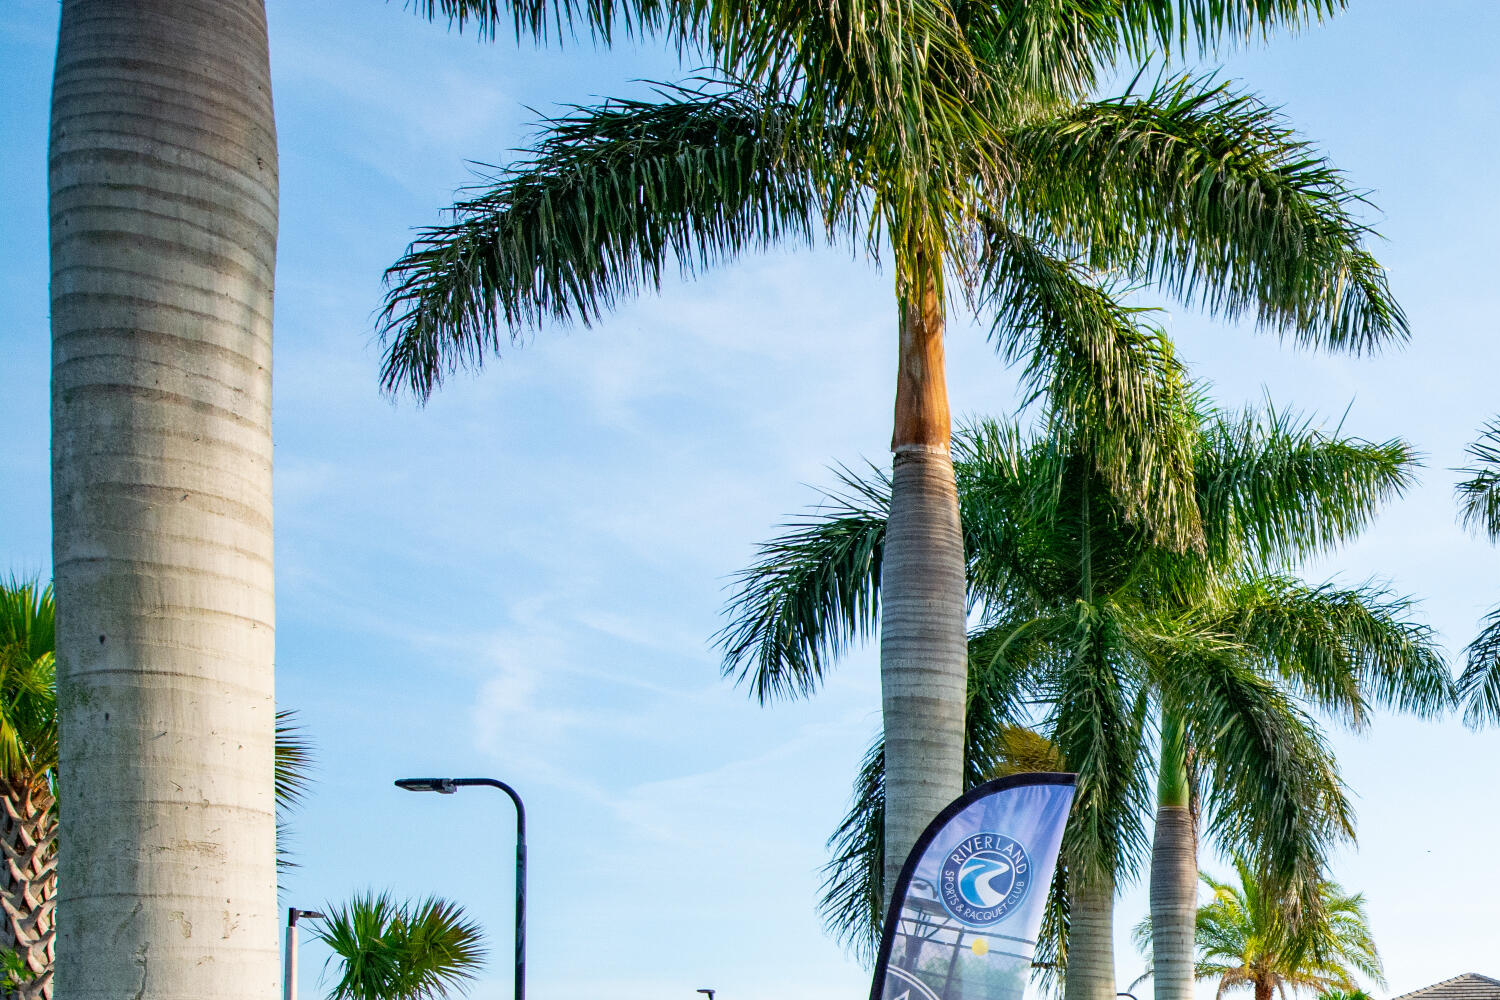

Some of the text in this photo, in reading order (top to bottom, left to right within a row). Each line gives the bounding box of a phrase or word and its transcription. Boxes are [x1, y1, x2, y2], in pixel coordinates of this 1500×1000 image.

[951, 835, 1027, 874] RIVERLAND
[944, 870, 1025, 921] SPORTS & RACQUET CLUB
